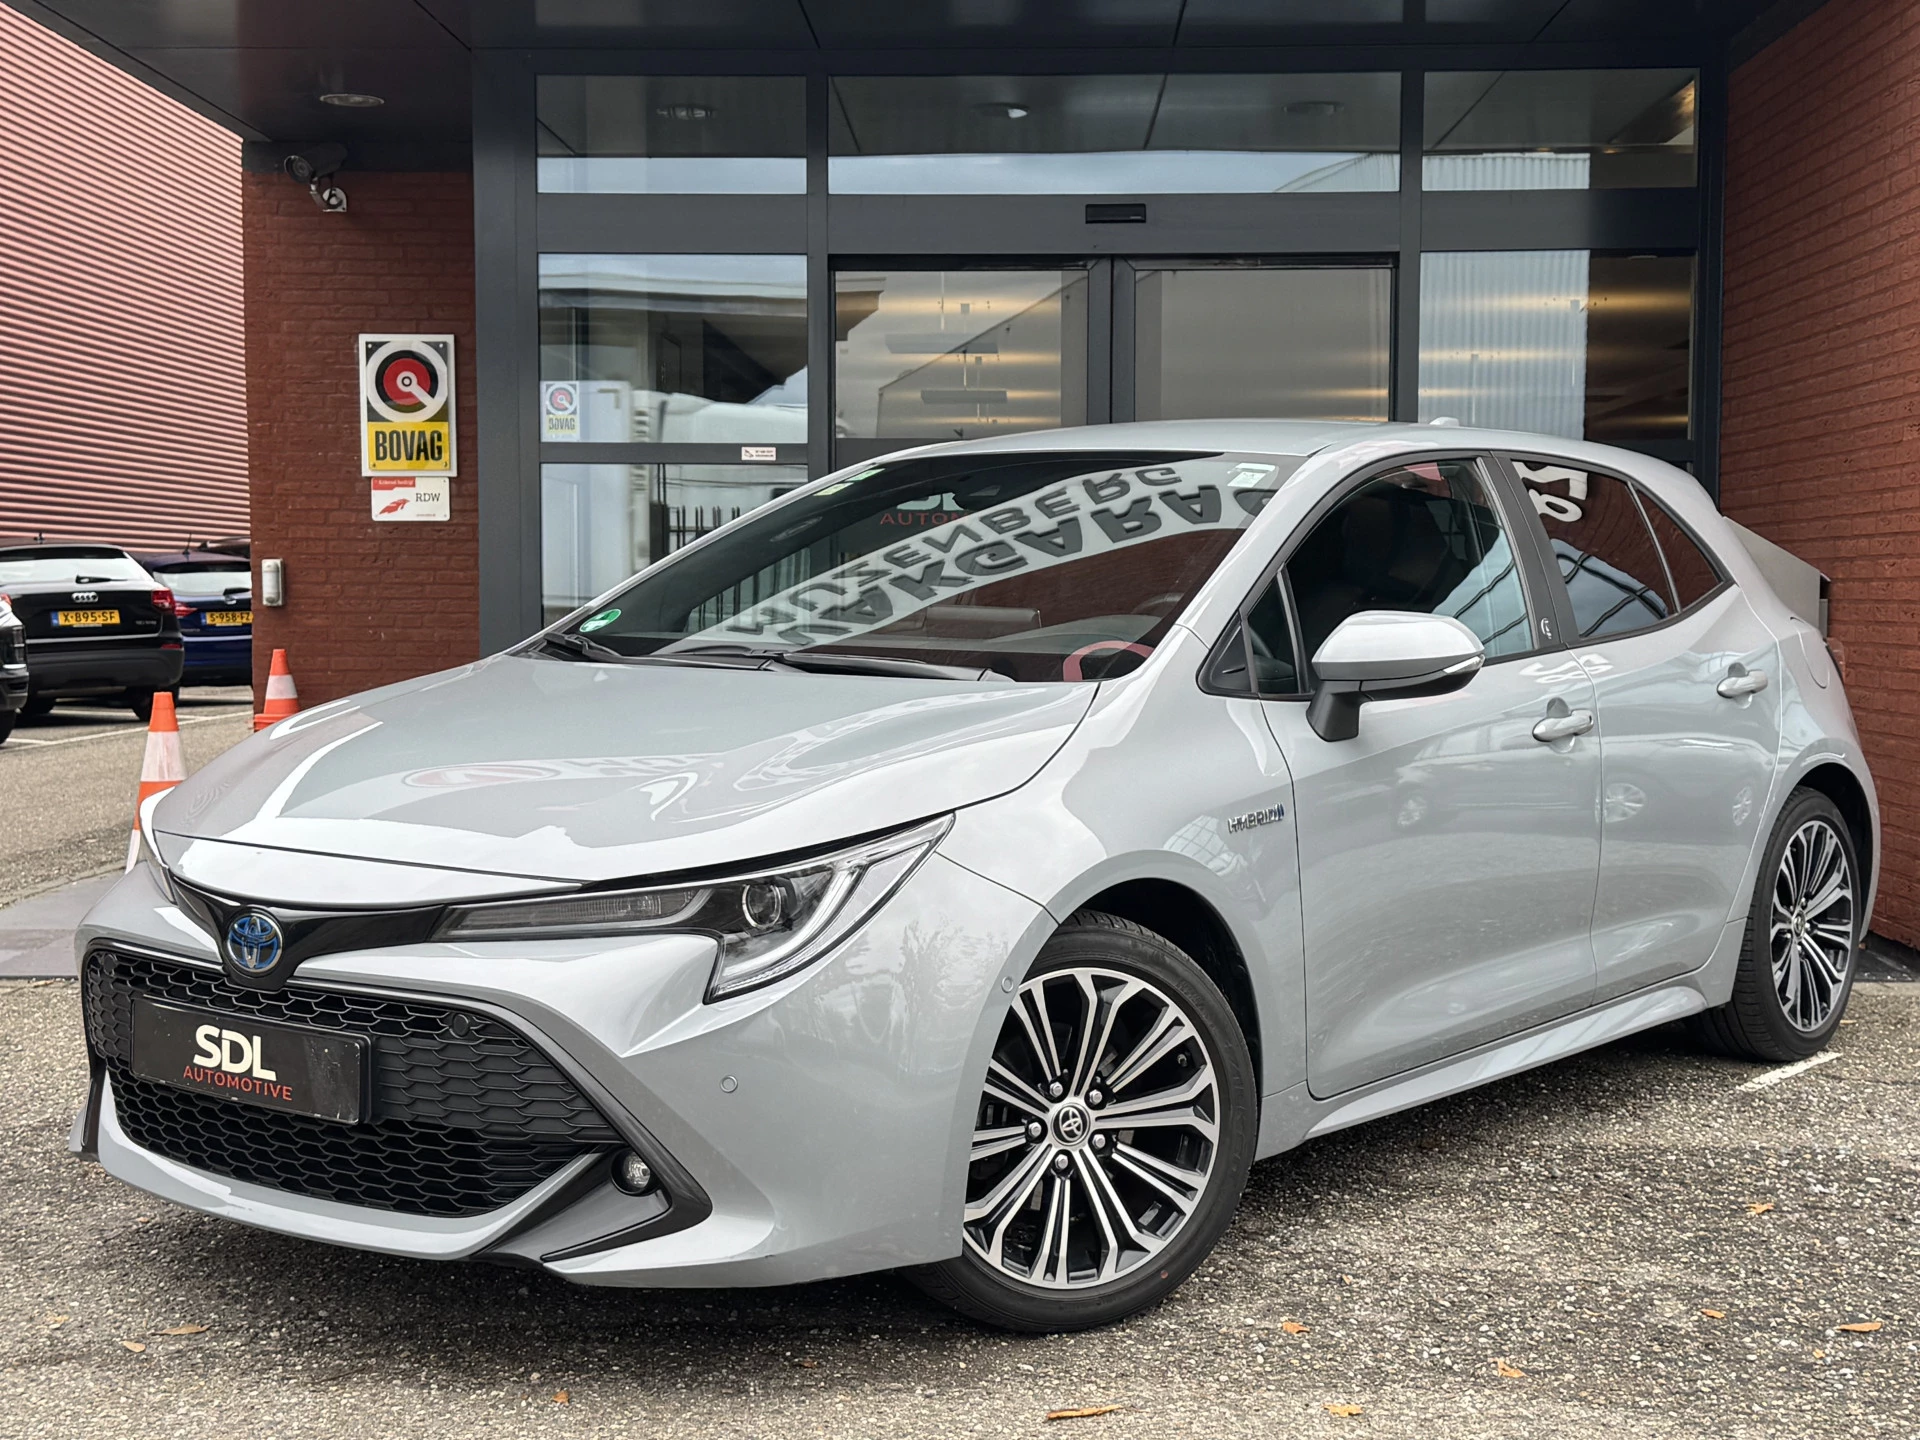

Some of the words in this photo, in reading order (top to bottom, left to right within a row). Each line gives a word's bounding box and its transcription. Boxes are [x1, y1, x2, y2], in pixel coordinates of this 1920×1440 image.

[375, 430, 442, 461] BOVAG
[415, 492, 441, 502] RDW
[1227, 805, 1281, 834] HYBRID
[192, 1024, 277, 1082] SDL
[182, 1064, 294, 1101] AUTOMOTIVE
